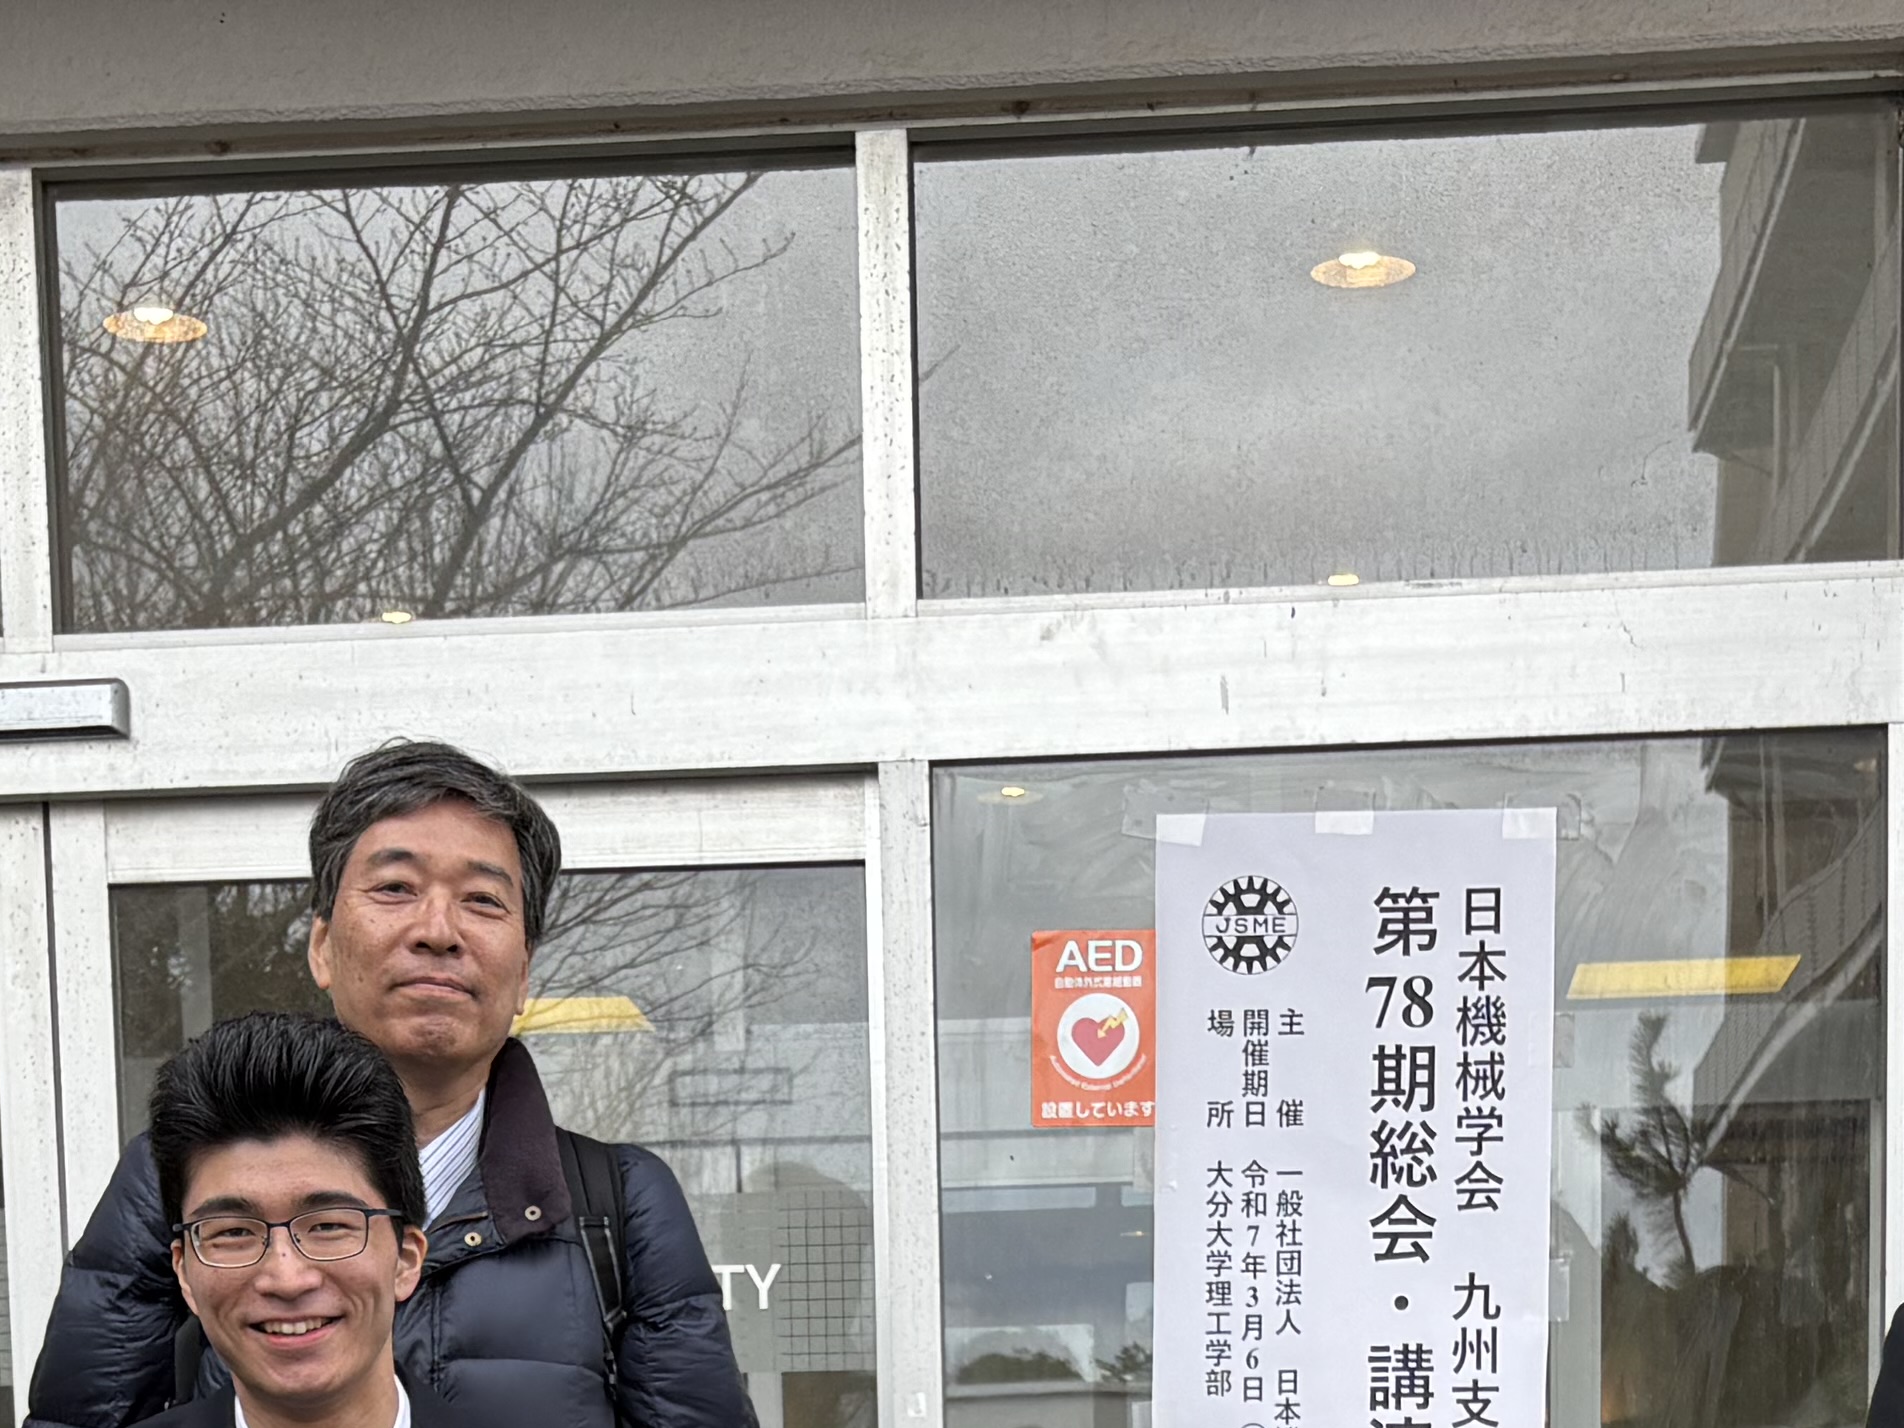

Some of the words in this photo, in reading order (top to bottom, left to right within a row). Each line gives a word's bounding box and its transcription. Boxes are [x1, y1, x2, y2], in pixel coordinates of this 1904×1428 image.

[1055, 939, 1144, 973] AED
[1215, 916, 1287, 934] JSME
[1241, 1008, 1270, 1128] 開催期日
[1453, 886, 1508, 1212] 日本機械学会
[1040, 1100, 1155, 1119] 設置しています
[1204, 1159, 1234, 1398] 大分大学理工学部
[1274, 1169, 1304, 1336] 一般社団法人
